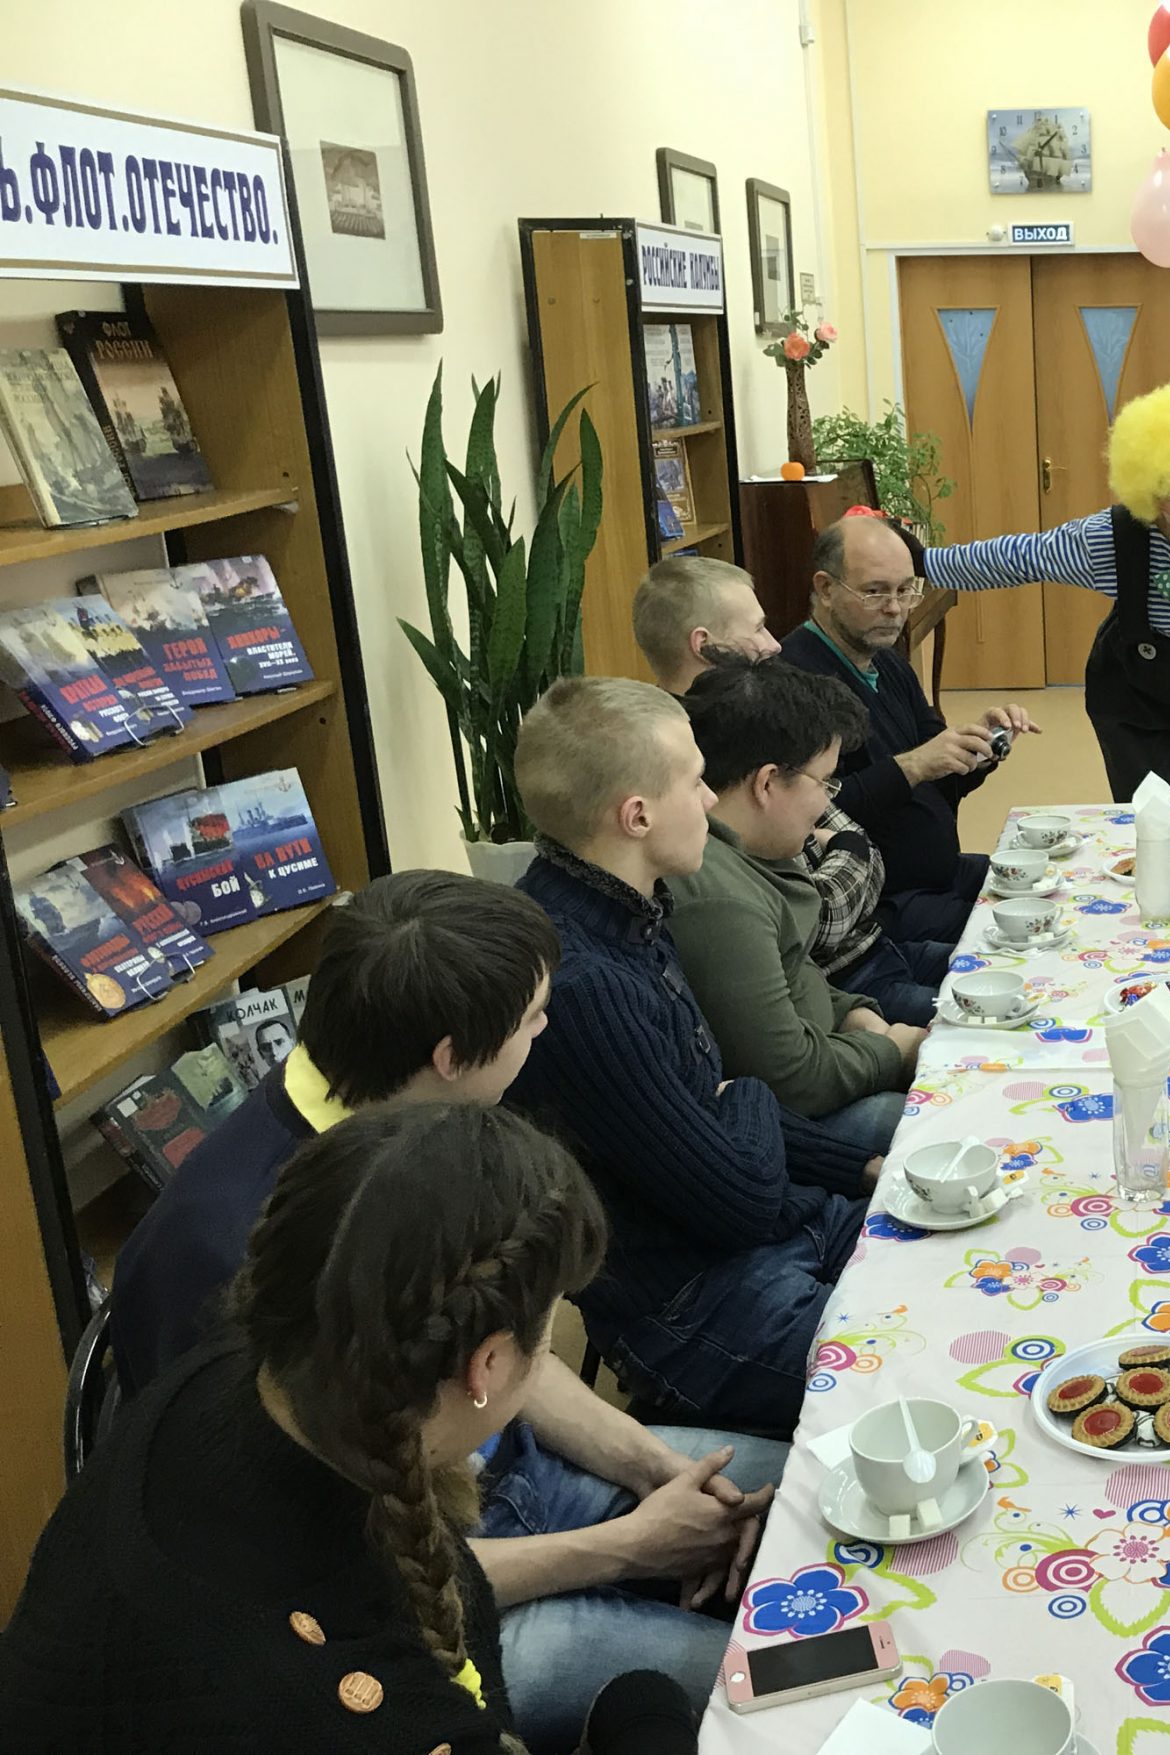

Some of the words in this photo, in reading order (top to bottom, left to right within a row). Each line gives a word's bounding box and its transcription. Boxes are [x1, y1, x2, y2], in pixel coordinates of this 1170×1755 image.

[1014, 227, 1068, 241] ВЫХОД
[642, 242, 687, 289] РОССИЙСКИЕ
[689, 252, 720, 291] КОЛУМБЫ
[95, 340, 154, 360] РОССИИ
[162, 637, 208, 661] ГЕРОИ
[246, 641, 294, 656] ВЛАСТИТЕЛИ
[275, 837, 313, 864] ПУТИ
[268, 868, 277, 880] К
[277, 856, 319, 878] ЦУСИМЕ
[211, 875, 241, 899] БОЙ
[225, 997, 279, 1023] КОЛЧАК
